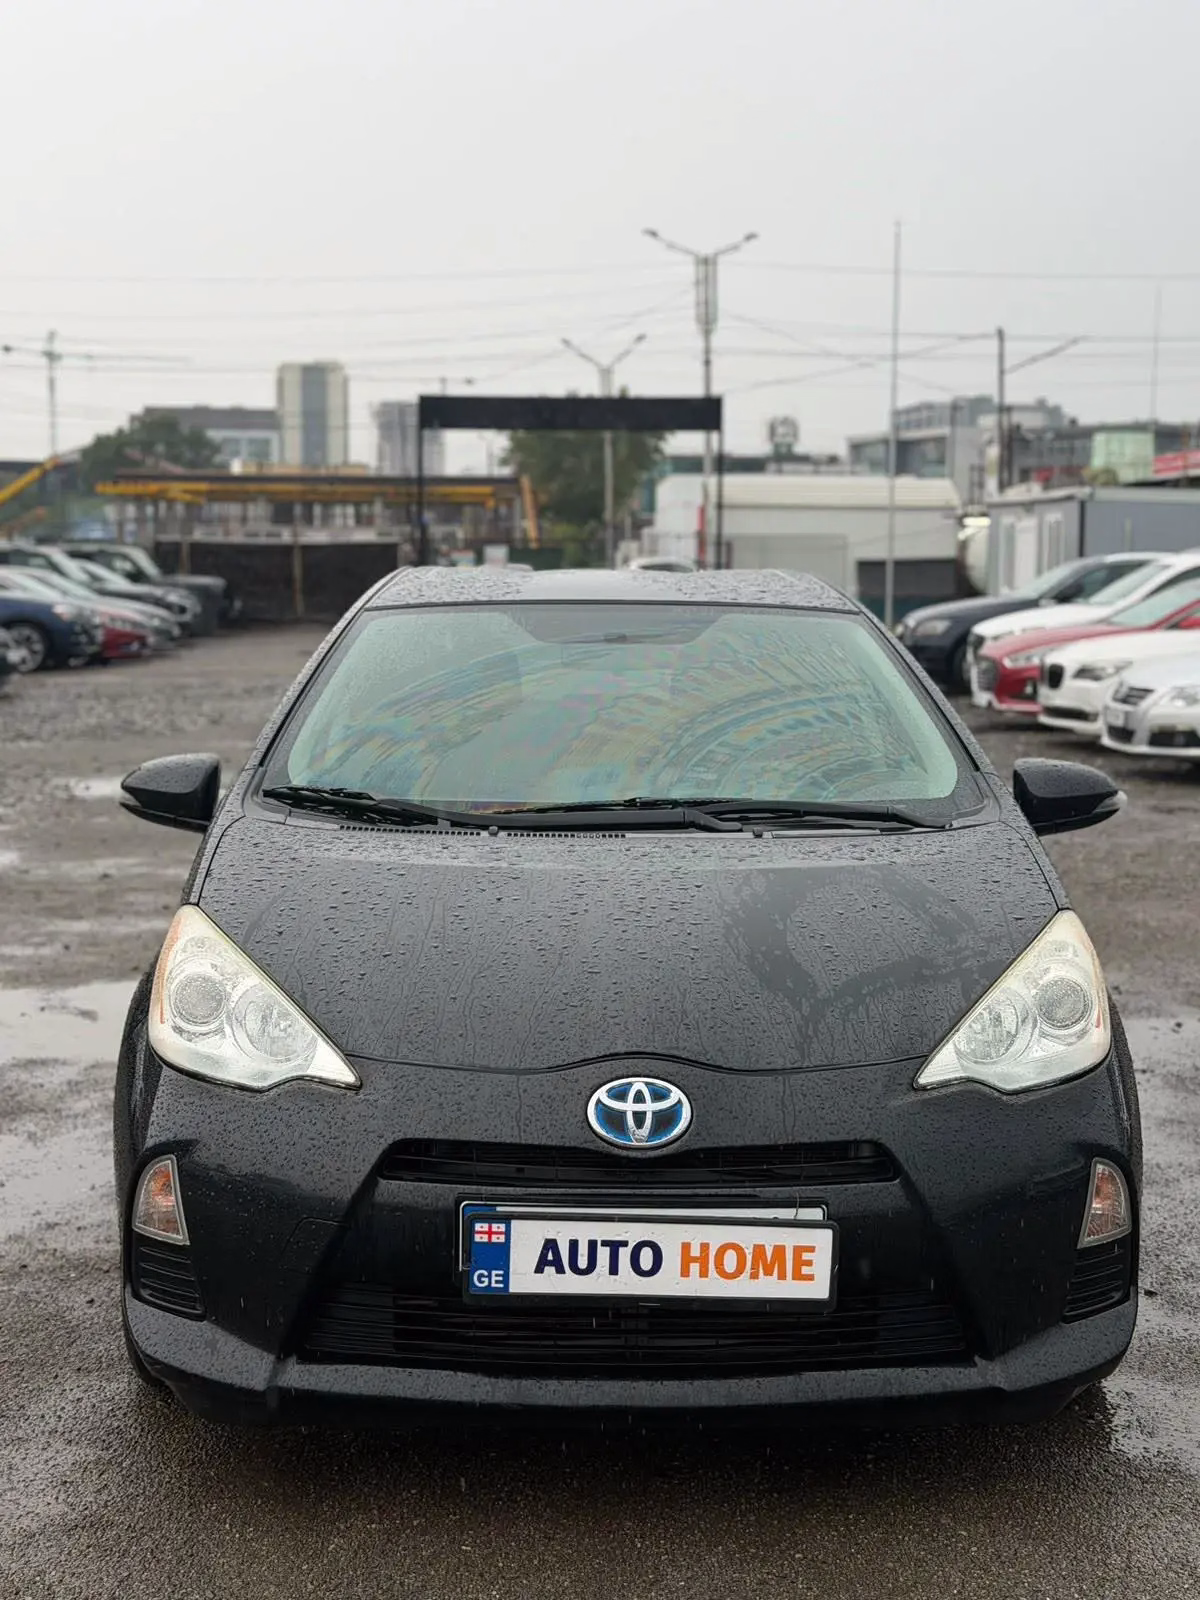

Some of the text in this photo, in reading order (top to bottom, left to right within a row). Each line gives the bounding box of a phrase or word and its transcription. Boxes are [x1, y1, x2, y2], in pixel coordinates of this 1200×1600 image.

[533, 1238, 816, 1282] AUTO HOME
[472, 1269, 505, 1288] GE
